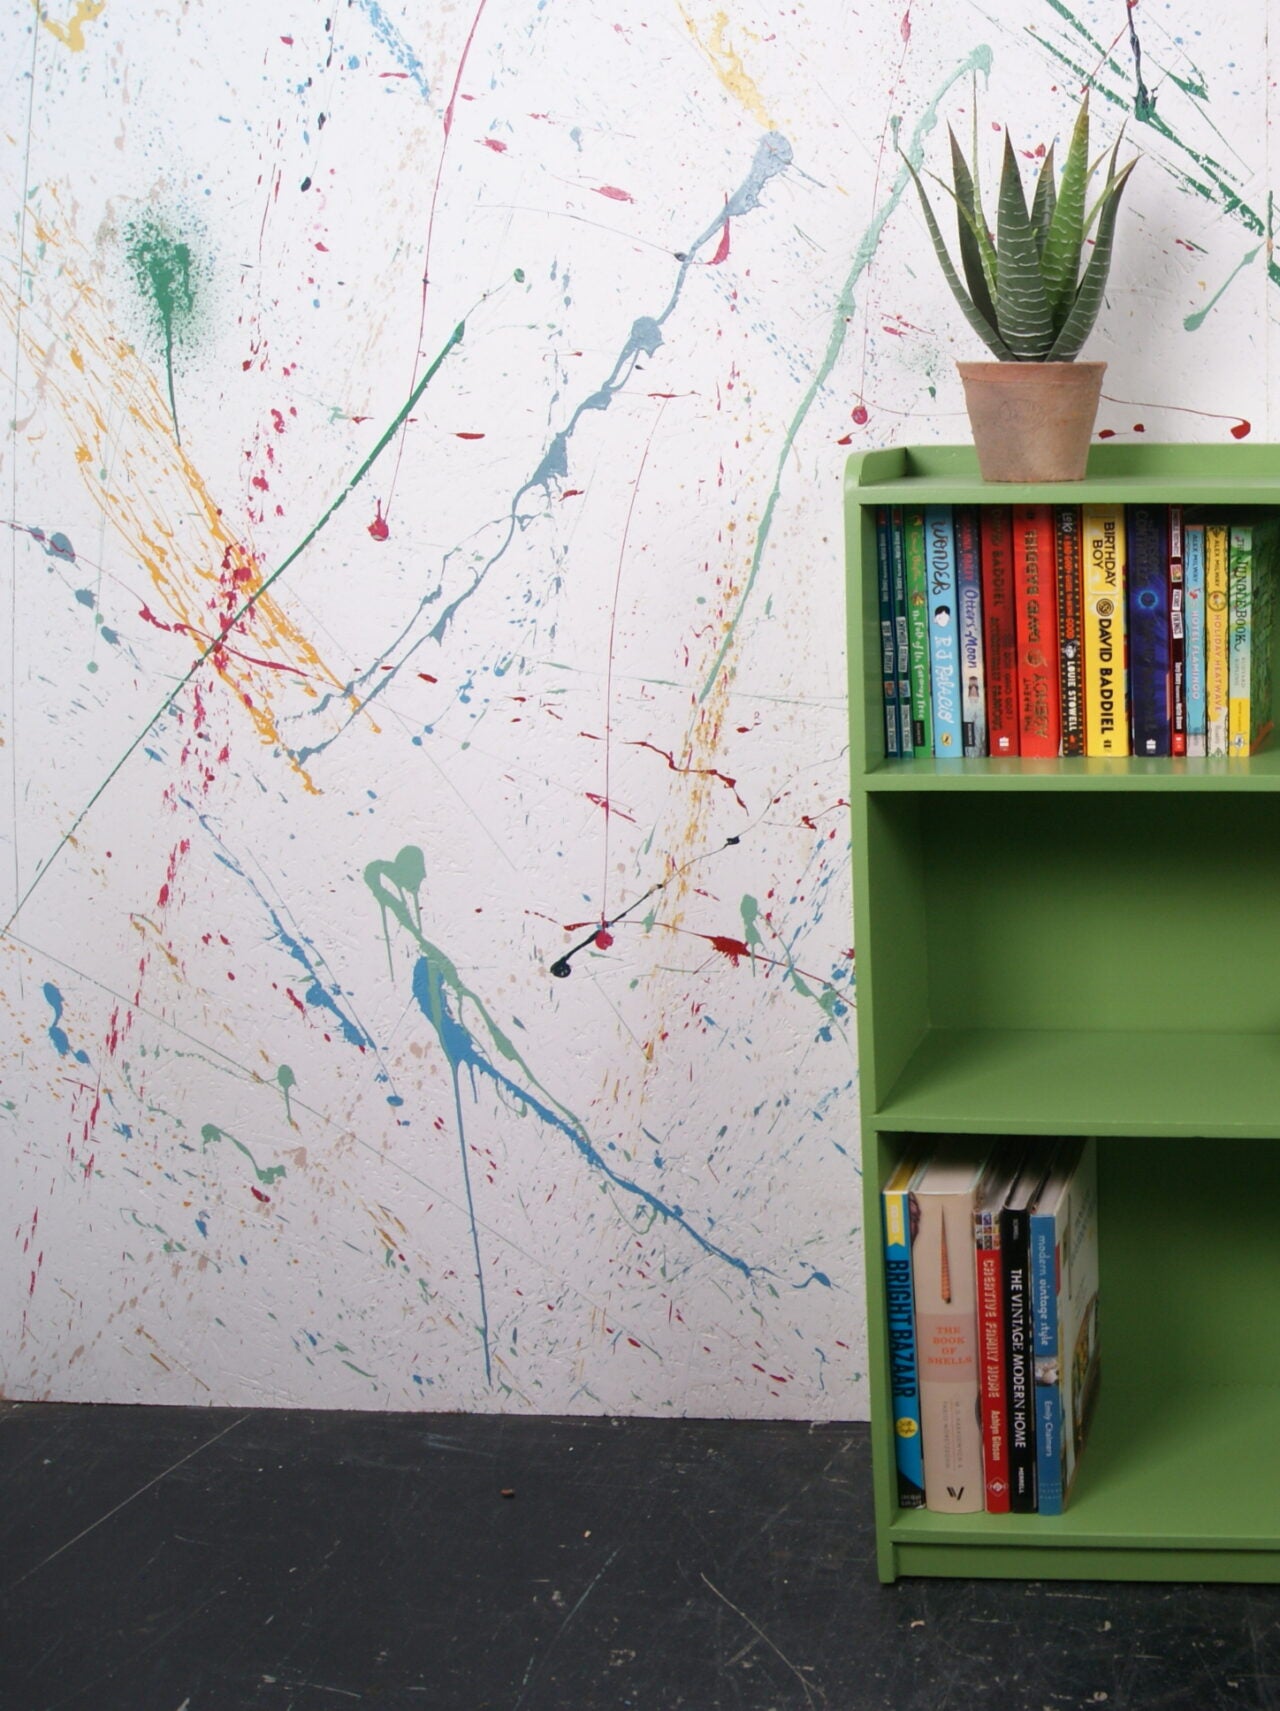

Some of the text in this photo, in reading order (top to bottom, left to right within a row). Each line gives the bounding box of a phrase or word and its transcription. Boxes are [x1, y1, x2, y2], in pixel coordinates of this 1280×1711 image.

[1092, 539, 1104, 570] BOY
[1103, 521, 1117, 588] BIRTHDAY
[1236, 561, 1248, 609] JUNGLE
[965, 630, 978, 668] Moon
[1191, 612, 1200, 700] HOTEL FLAMINGO
[1234, 610, 1247, 651] BOOK
[1067, 661, 1077, 731] LOUIE STOWELL
[1098, 618, 1114, 734] DAVID BADDIEL
[1214, 660, 1222, 711] HEATWAVE
[1038, 1235, 1053, 1346] modern vintage style
[888, 1259, 916, 1398] BRIGHT BAZAAR
[932, 1336, 966, 1344] BOOK
[936, 1326, 961, 1334] THE
[983, 1259, 1000, 1398] CREATIVE FAMILY HOME
[927, 1357, 972, 1366] SHELLS
[1010, 1269, 1026, 1448] THE VINTAGE MODERN HOME
[991, 1410, 1002, 1461] Ashlyn Gibson
